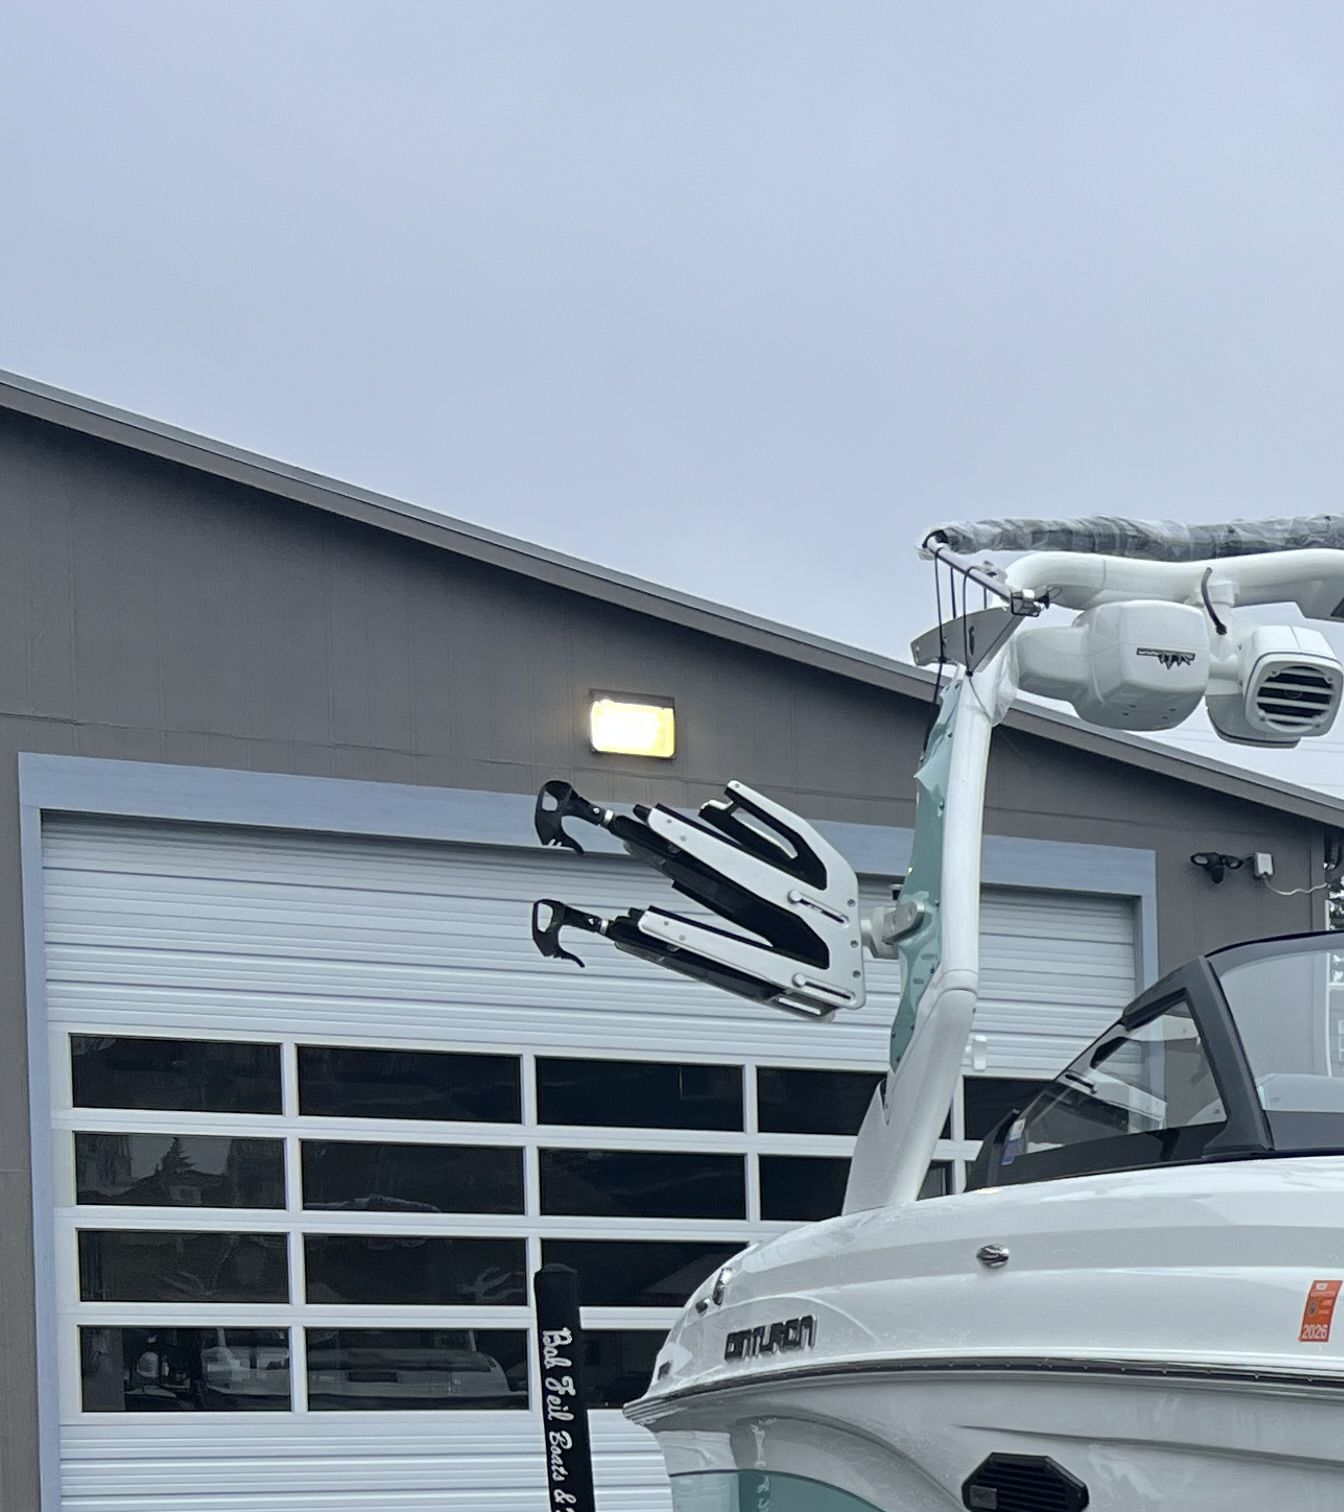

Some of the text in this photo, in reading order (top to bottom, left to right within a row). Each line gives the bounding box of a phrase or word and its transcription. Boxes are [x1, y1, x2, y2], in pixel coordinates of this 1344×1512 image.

[543, 1327, 573, 1370] Bob
[1301, 1323, 1328, 1339] 2026
[545, 1375, 575, 1421] Feil
[548, 1430, 573, 1482] Boats
[554, 1488, 577, 1504] &
